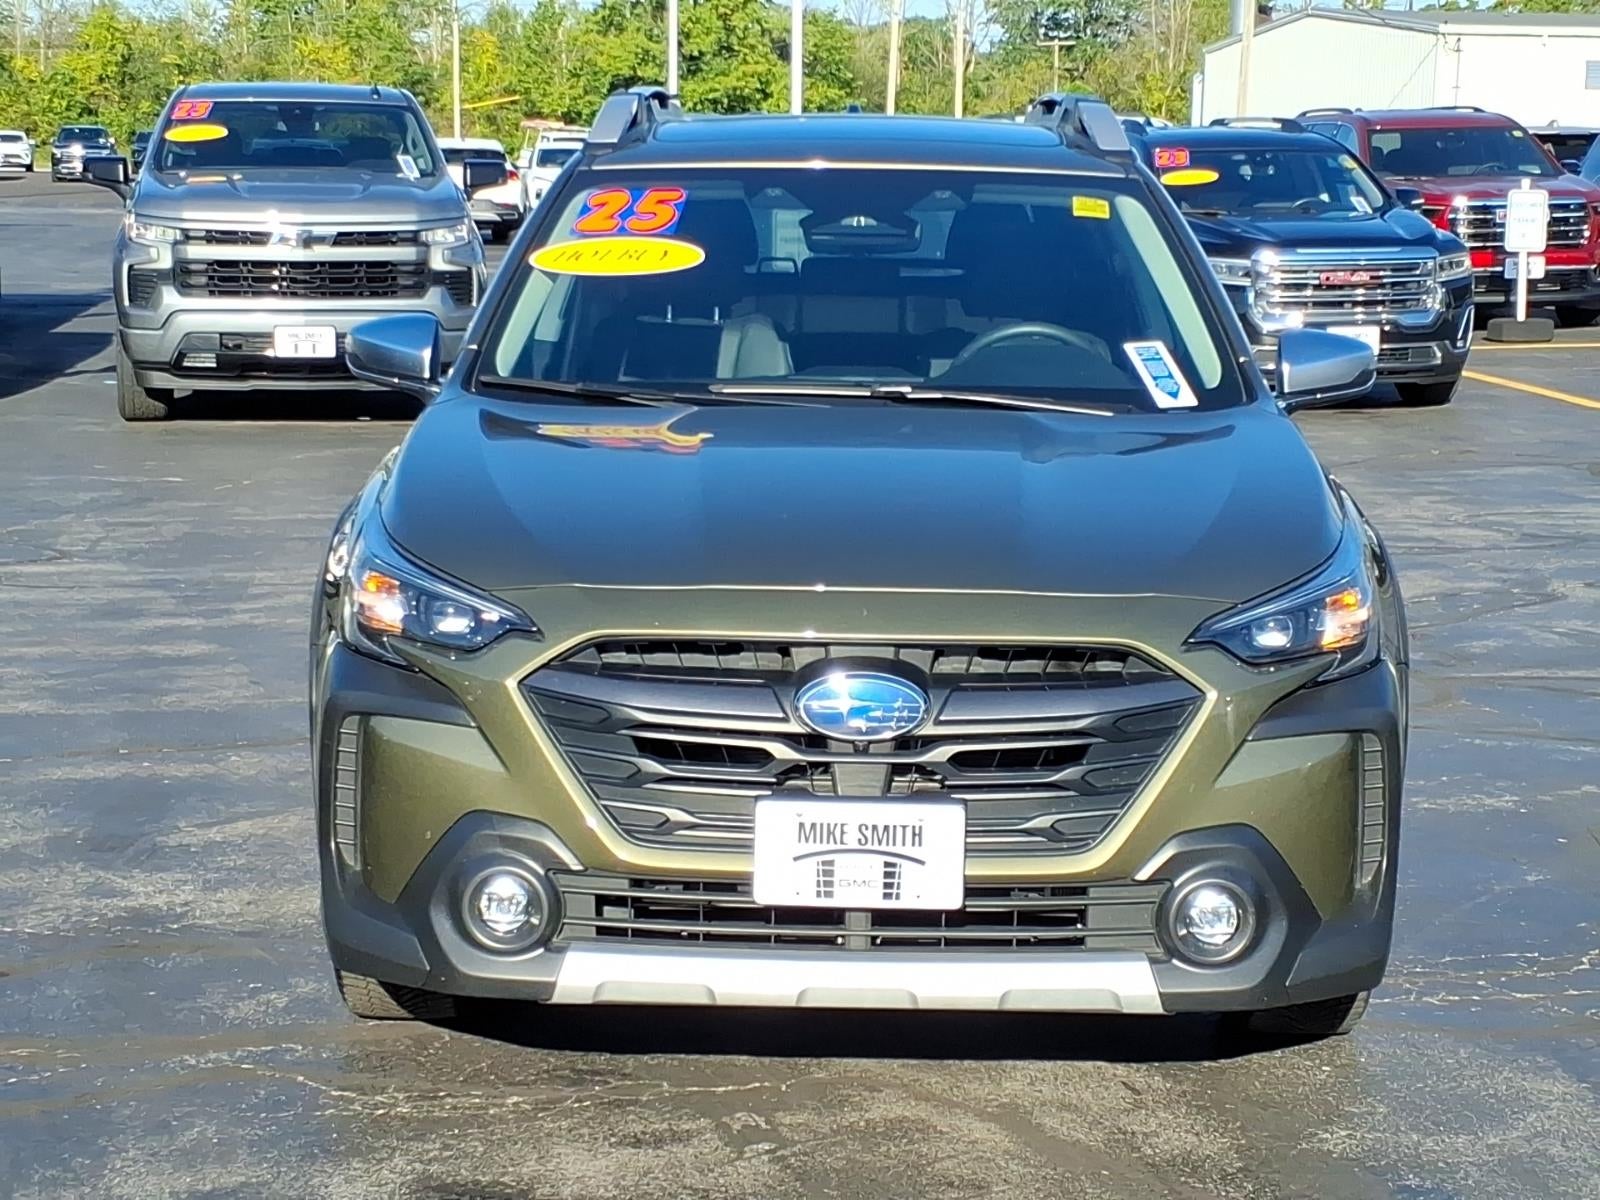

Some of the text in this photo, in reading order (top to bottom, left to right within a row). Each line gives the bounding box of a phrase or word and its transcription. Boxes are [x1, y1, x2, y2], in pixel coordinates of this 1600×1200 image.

[574, 187, 686, 234] 25
[797, 822, 924, 848] MIKE SMITH
[838, 878, 880, 889] GMC
